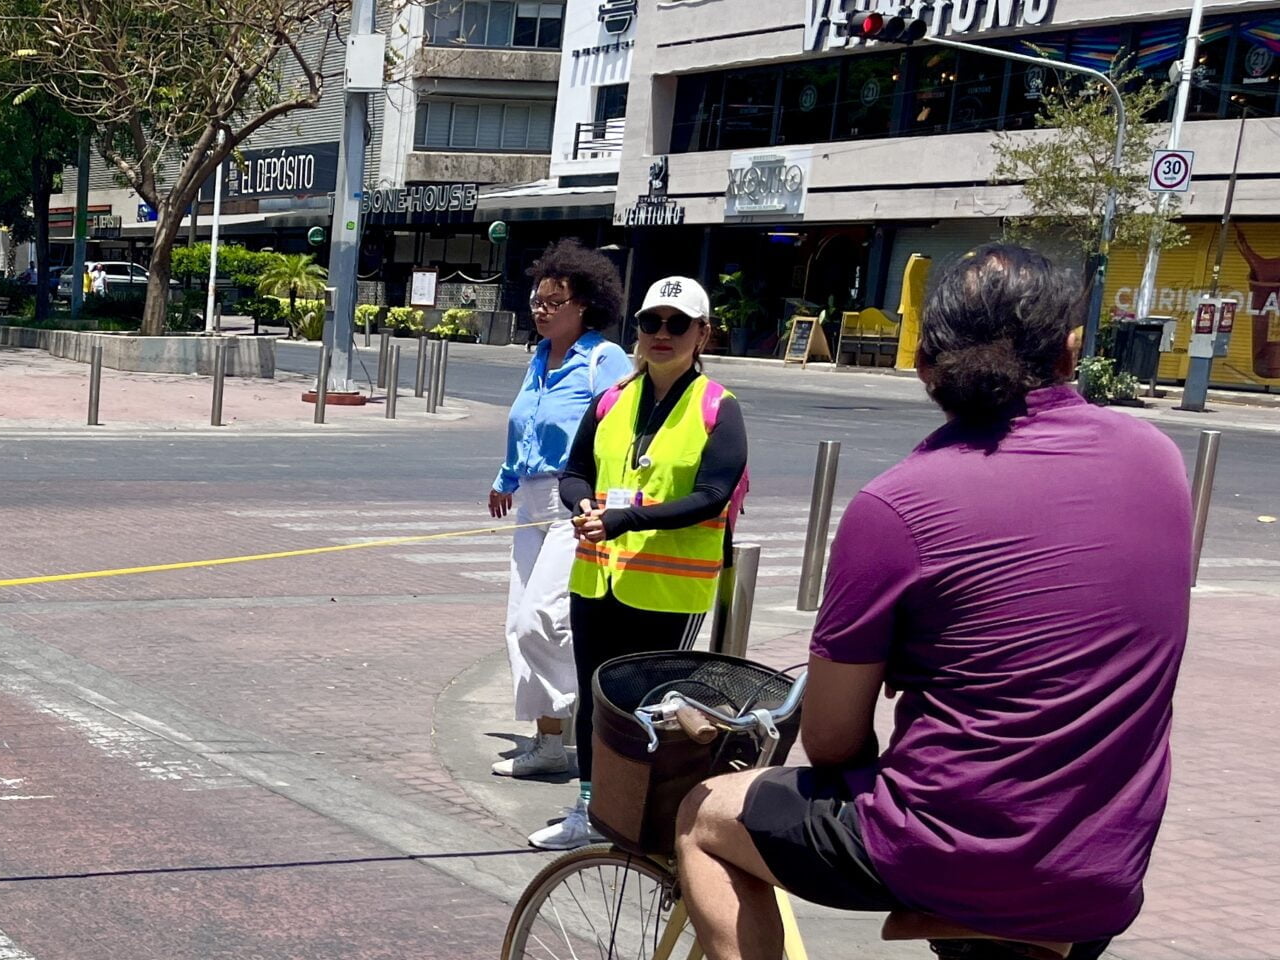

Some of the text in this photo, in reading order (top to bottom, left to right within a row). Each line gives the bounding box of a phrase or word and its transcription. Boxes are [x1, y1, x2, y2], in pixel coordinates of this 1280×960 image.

[241, 159, 256, 194] EL
[256, 150, 315, 193] DEPÓSITO
[1162, 160, 1182, 175] 30
[361, 188, 407, 214] BONE
[410, 183, 476, 212] HOUSE
[623, 206, 681, 225] VEINTIUNO
